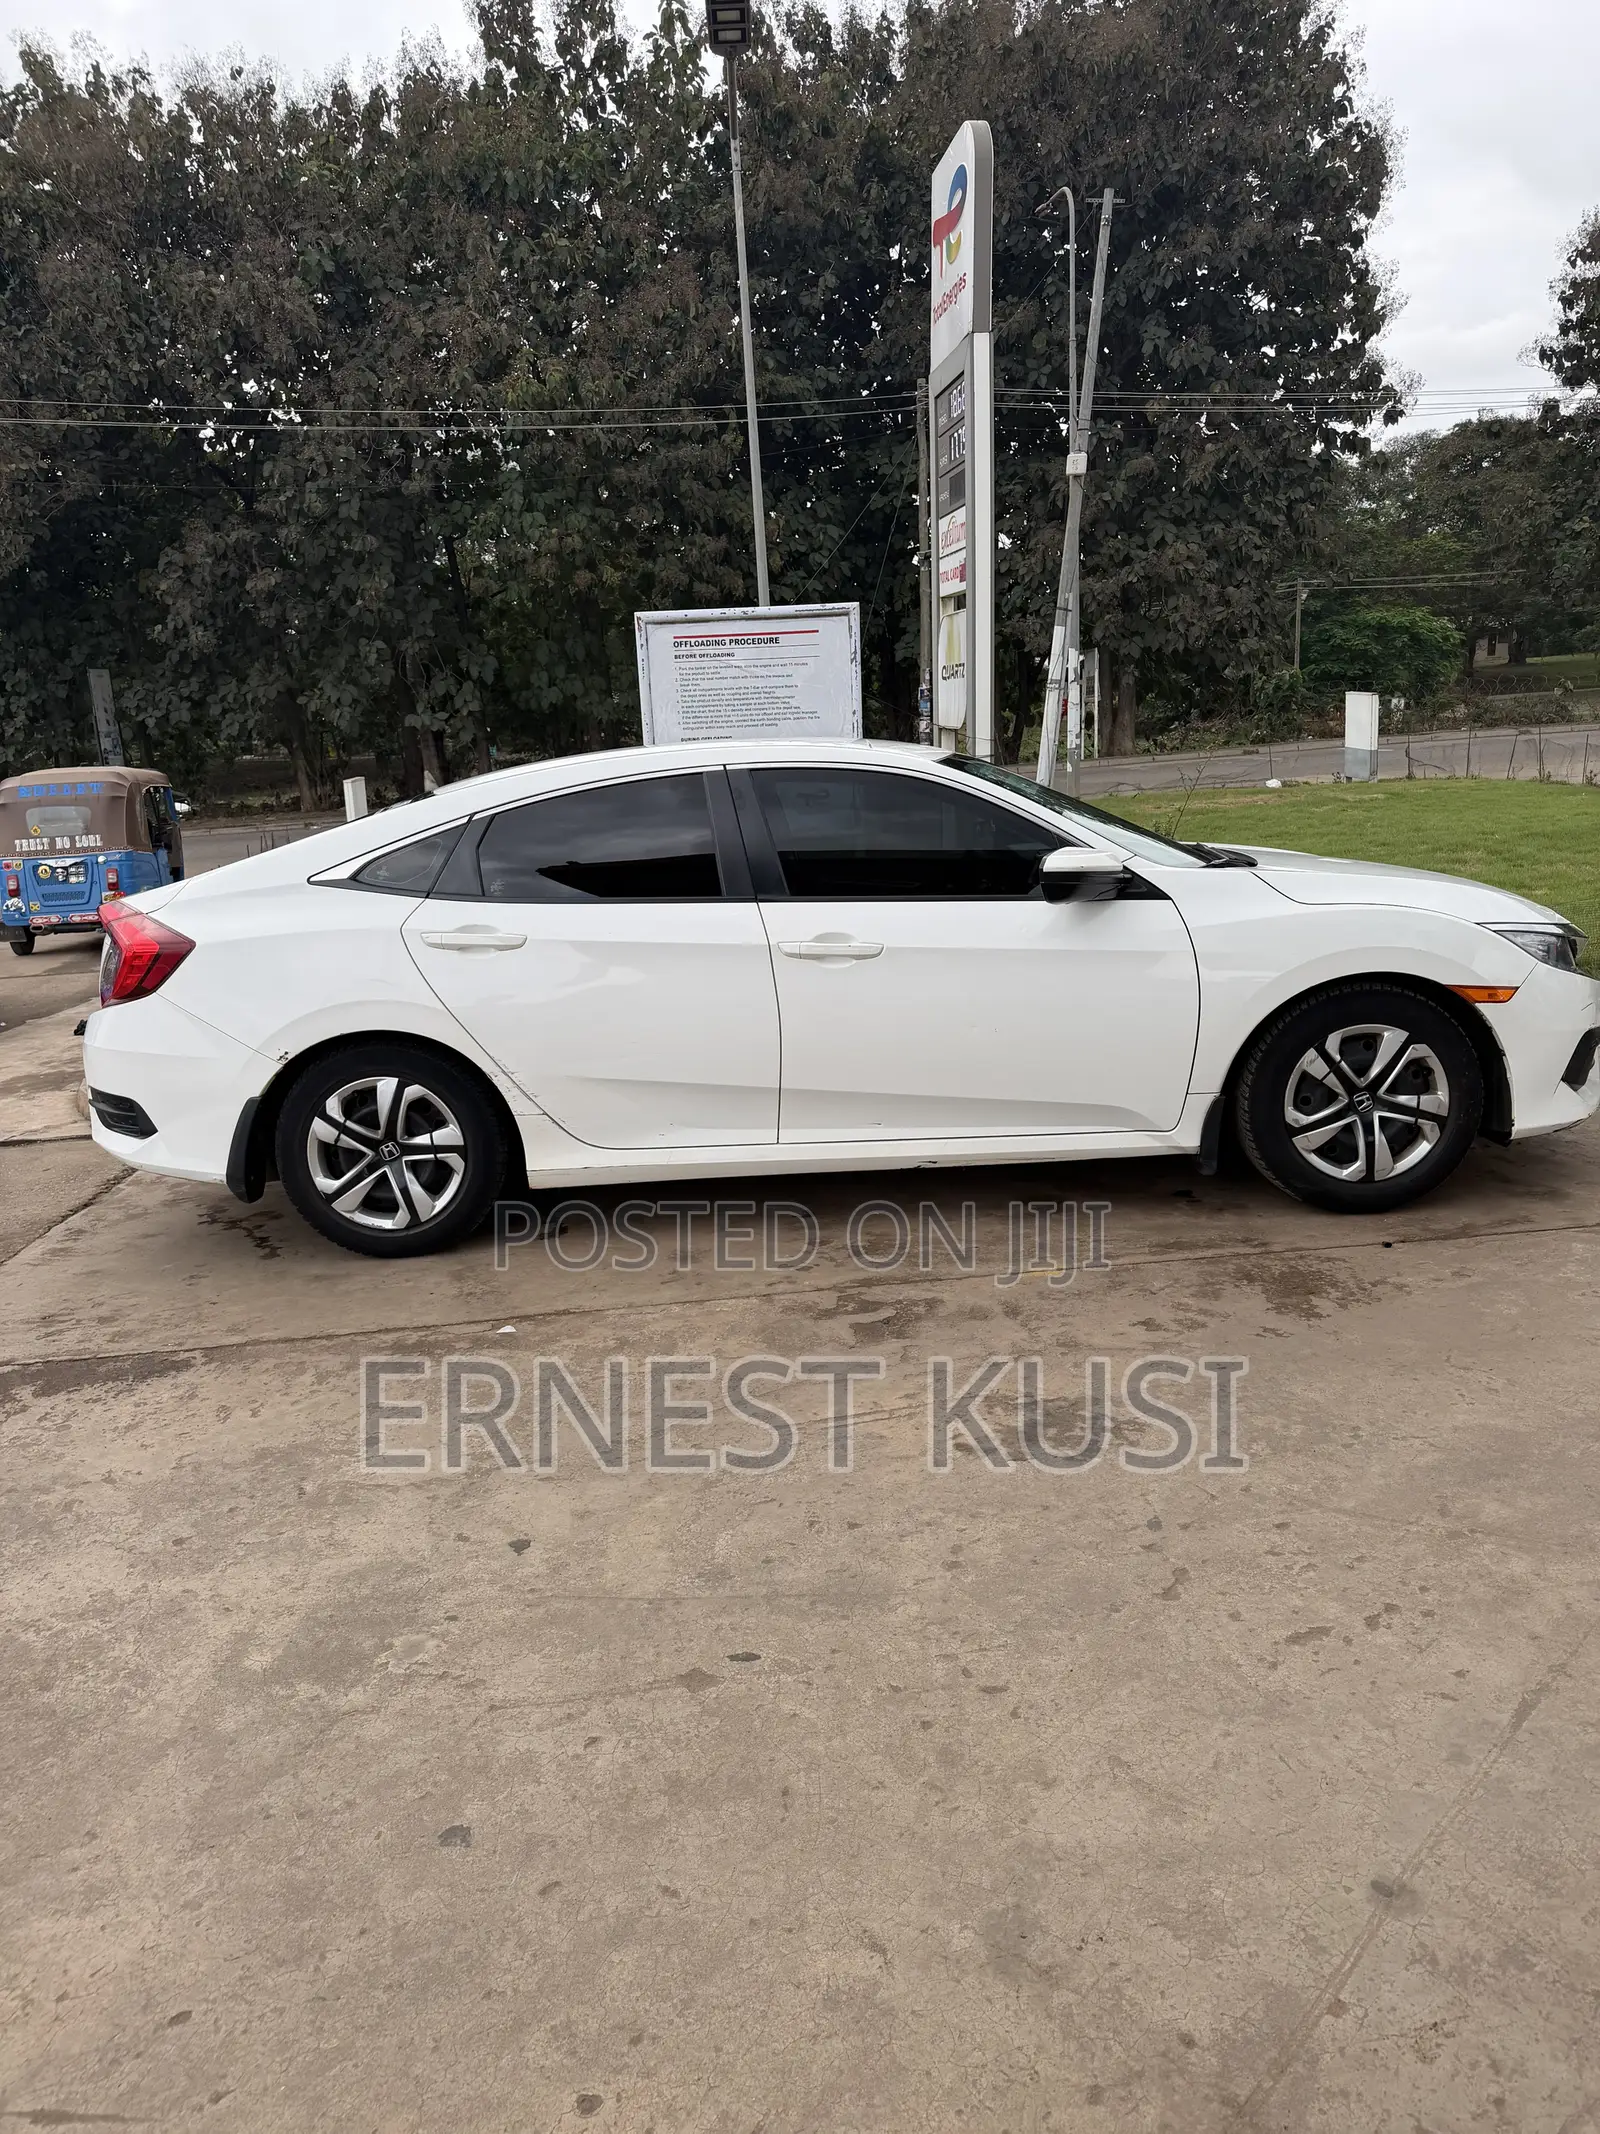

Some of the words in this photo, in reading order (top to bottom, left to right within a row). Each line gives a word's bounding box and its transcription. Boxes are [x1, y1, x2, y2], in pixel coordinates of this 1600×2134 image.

[673, 639, 726, 648] OFFLOADING
[729, 637, 780, 646] PROCEDURE
[942, 662, 965, 681] QUARTZ
[14, 837, 50, 852] TRUST
[55, 836, 70, 849] NO
[75, 834, 103, 848] SOUL
